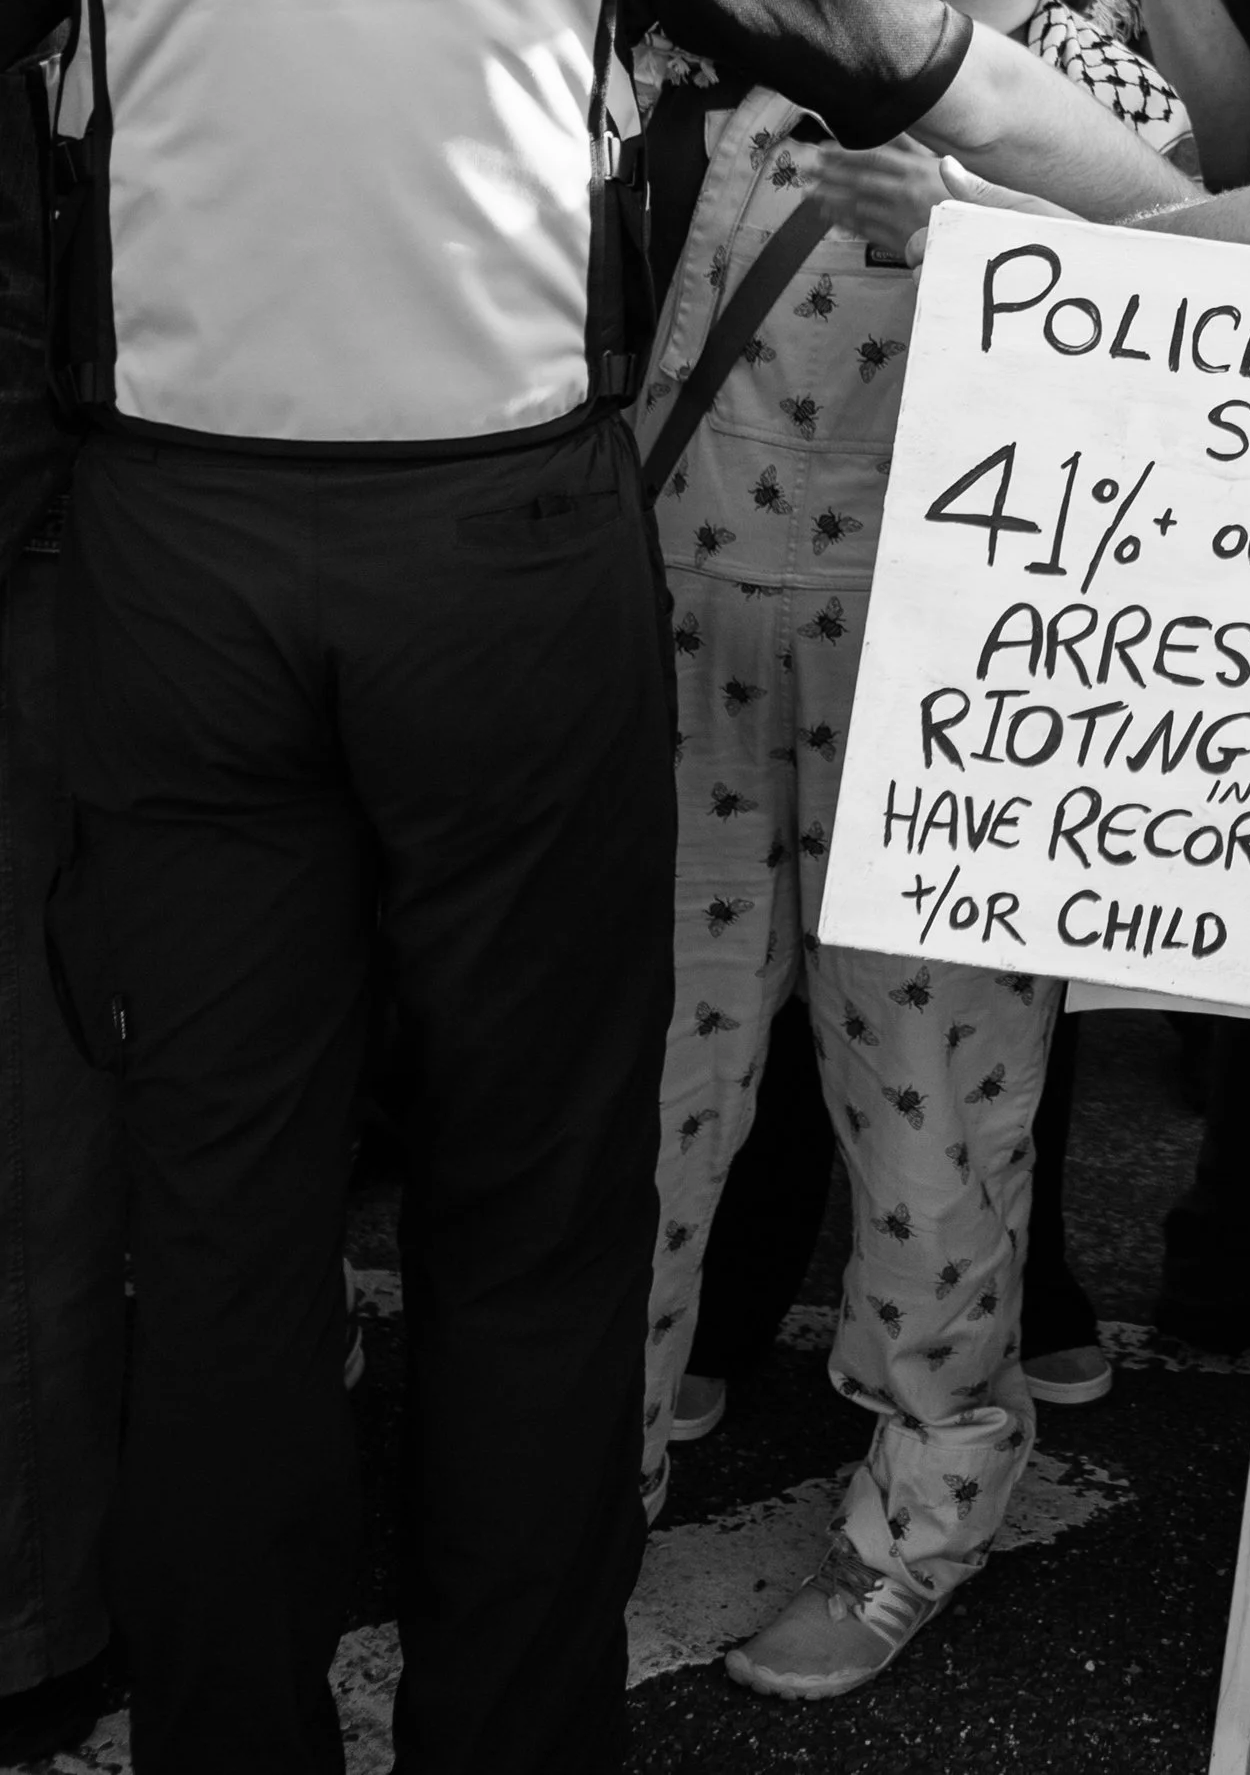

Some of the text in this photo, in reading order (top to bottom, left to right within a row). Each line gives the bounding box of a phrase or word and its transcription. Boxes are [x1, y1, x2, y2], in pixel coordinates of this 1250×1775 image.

[884, 779, 1032, 855] HAVE
[901, 864, 1027, 945] +/OR
[1057, 889, 1227, 959] CHILD
